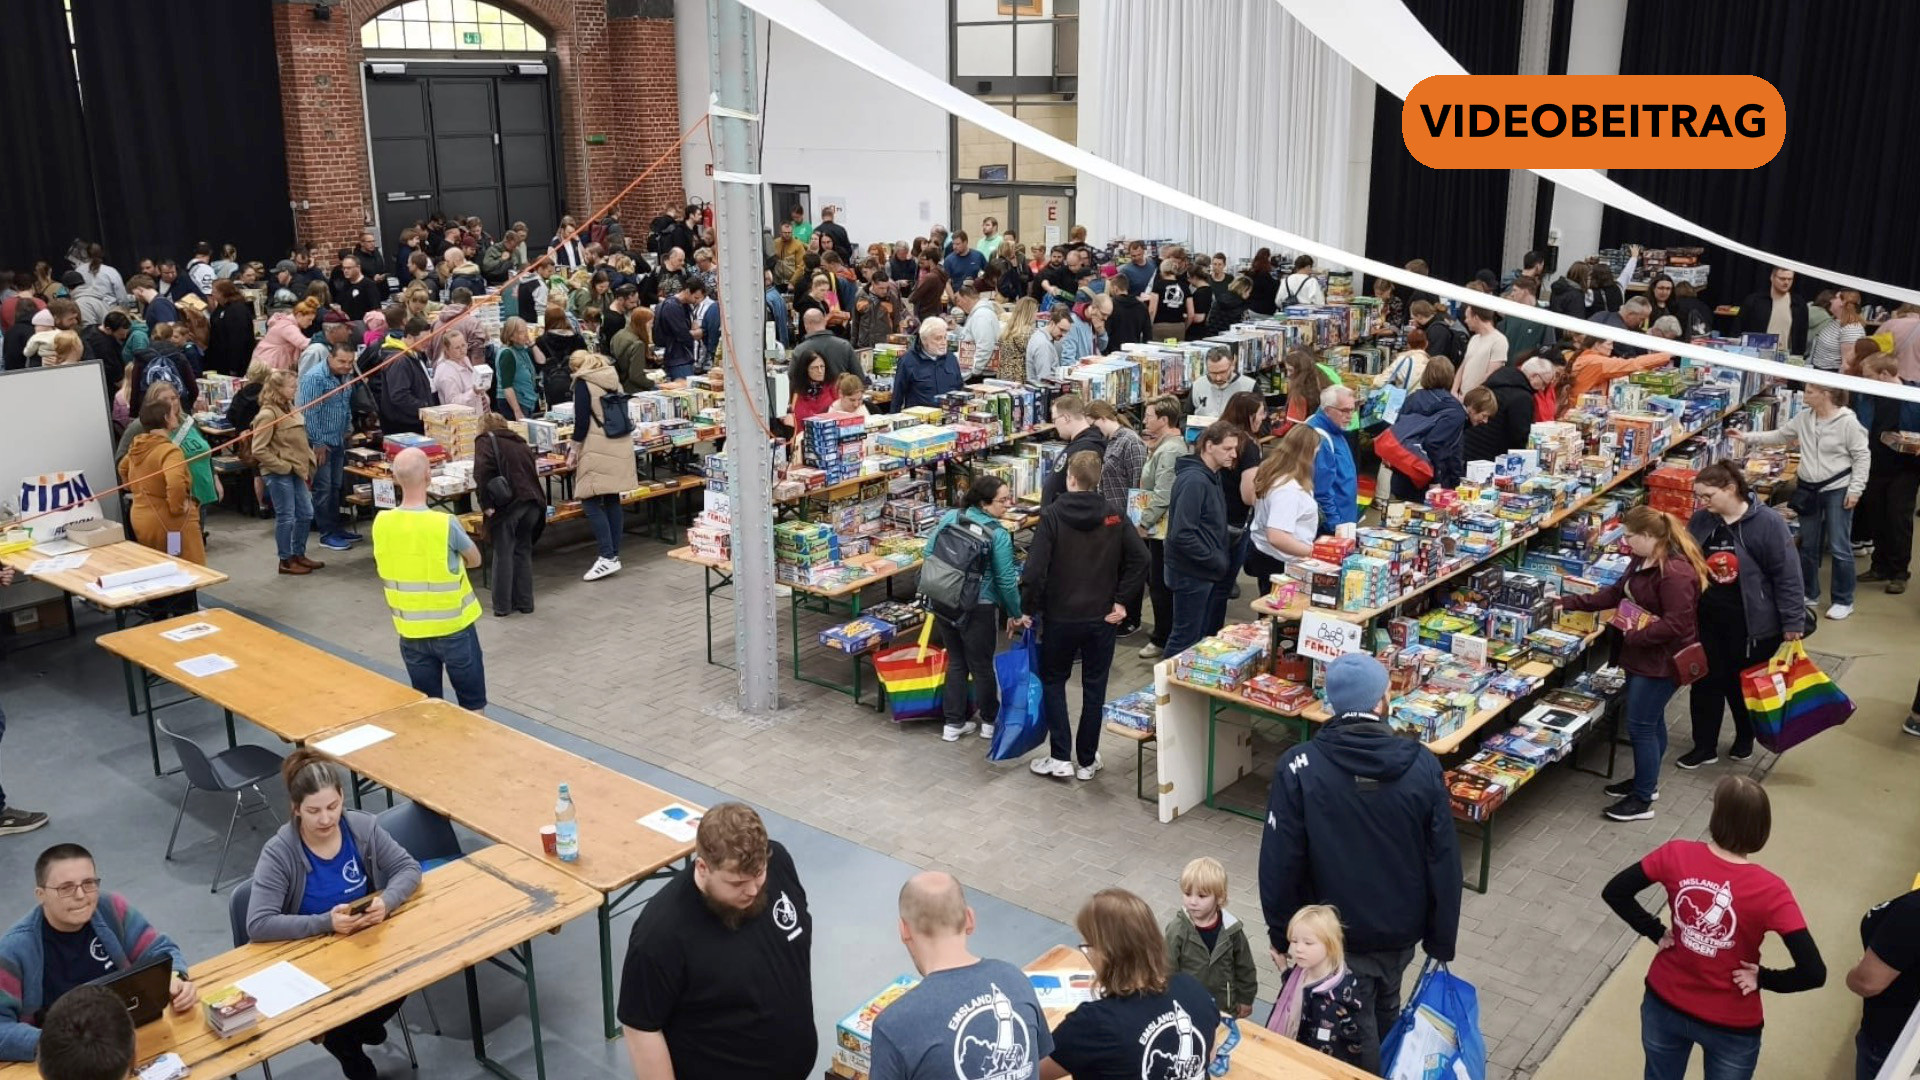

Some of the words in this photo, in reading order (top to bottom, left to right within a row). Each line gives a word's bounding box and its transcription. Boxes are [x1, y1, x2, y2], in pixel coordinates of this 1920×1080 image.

[1048, 206, 1057, 221] E
[1679, 878, 1720, 892] EMSLAND
[948, 993, 993, 1031] EMSLAND
[1138, 1011, 1176, 1046] EMSLAND
